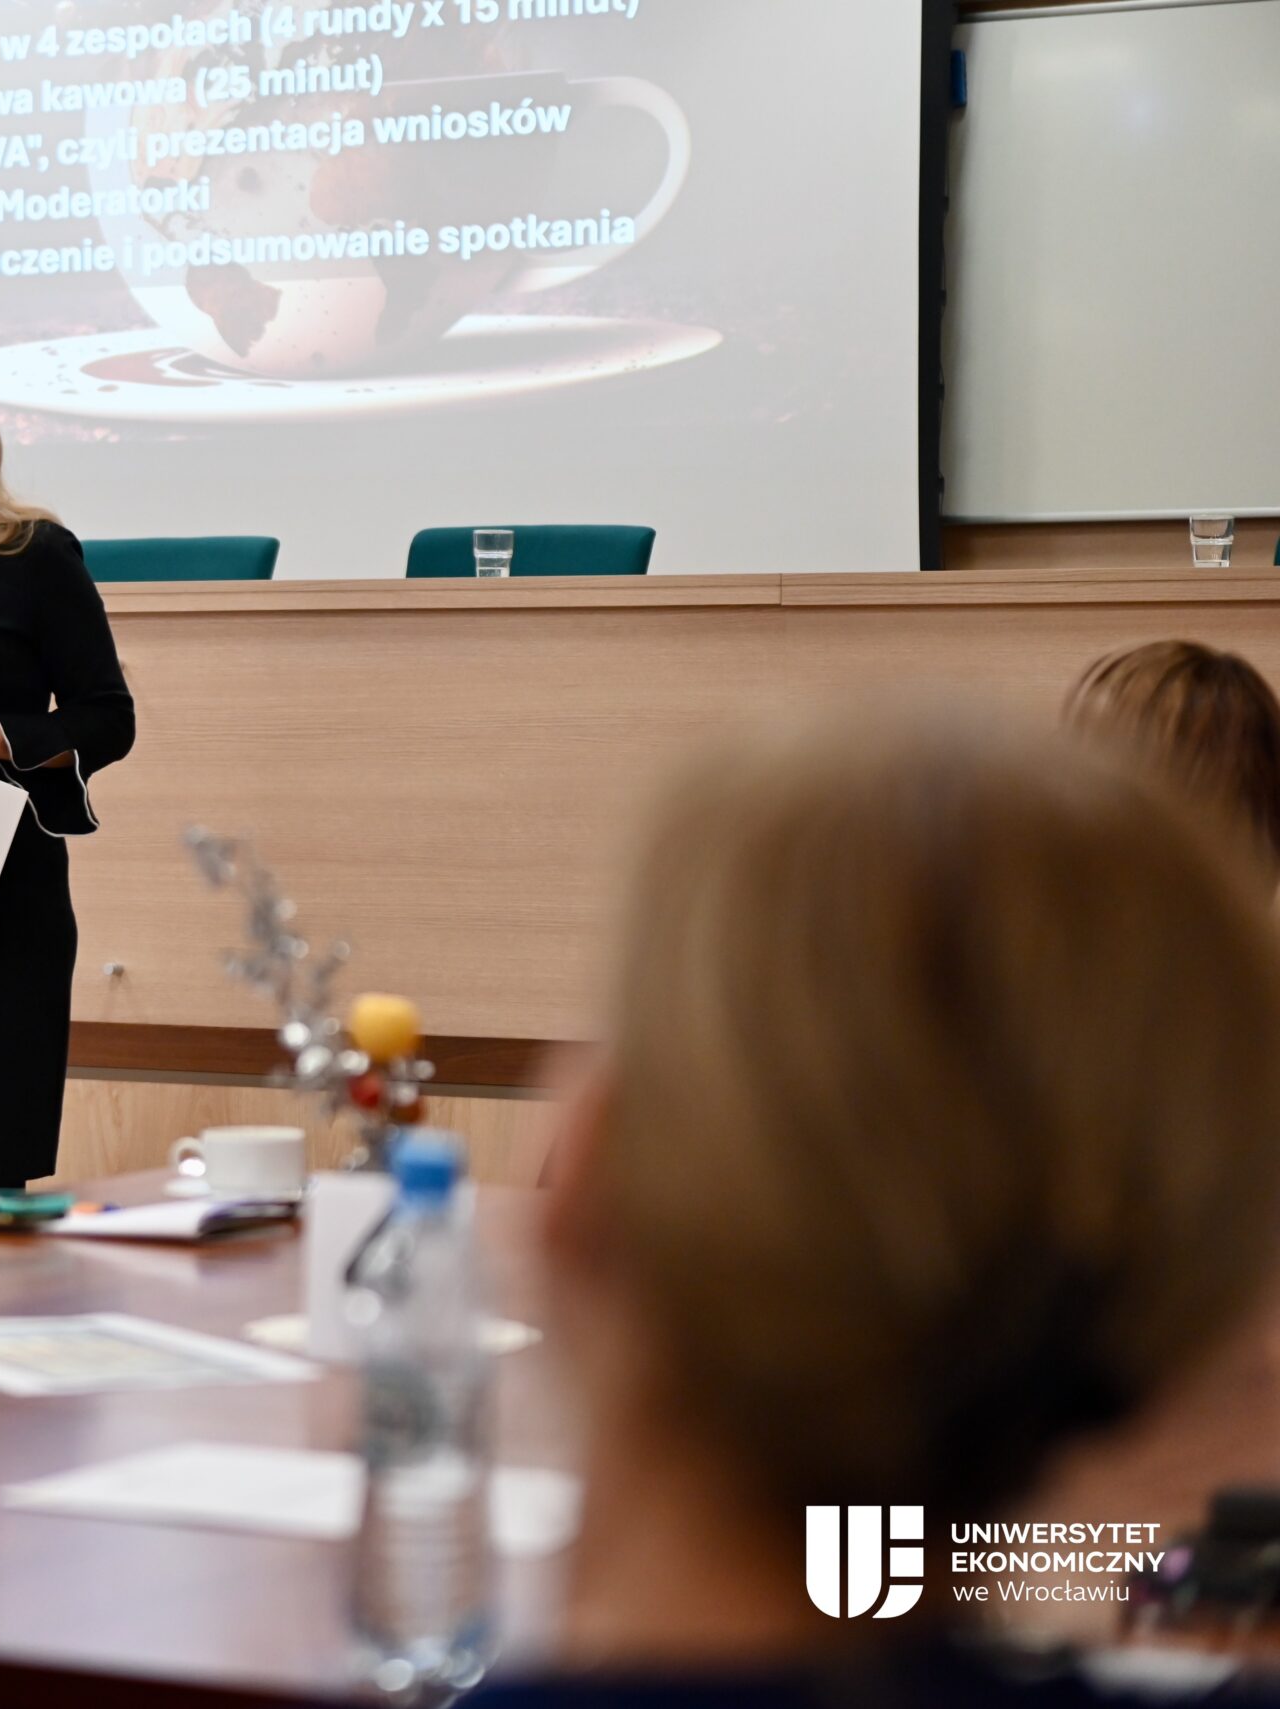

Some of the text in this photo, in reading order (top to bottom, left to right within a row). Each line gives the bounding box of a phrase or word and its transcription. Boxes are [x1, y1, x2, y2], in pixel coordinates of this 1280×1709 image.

[0, 35, 31, 61] w
[36, 28, 60, 57] 4
[66, 9, 253, 57] zespołach
[259, 4, 297, 49] (4
[304, 1, 415, 39] rundy
[420, 1, 446, 28] x
[459, 0, 500, 24] 15
[40, 75, 187, 112] kawowa
[194, 67, 252, 108] (25
[258, 54, 384, 96] minut)
[56, 126, 138, 170] czyli
[145, 111, 365, 166] prezentacja
[373, 97, 572, 145] wniosków
[123, 238, 134, 270] i
[142, 221, 430, 276] podsumowanie
[438, 208, 636, 260] spotkania
